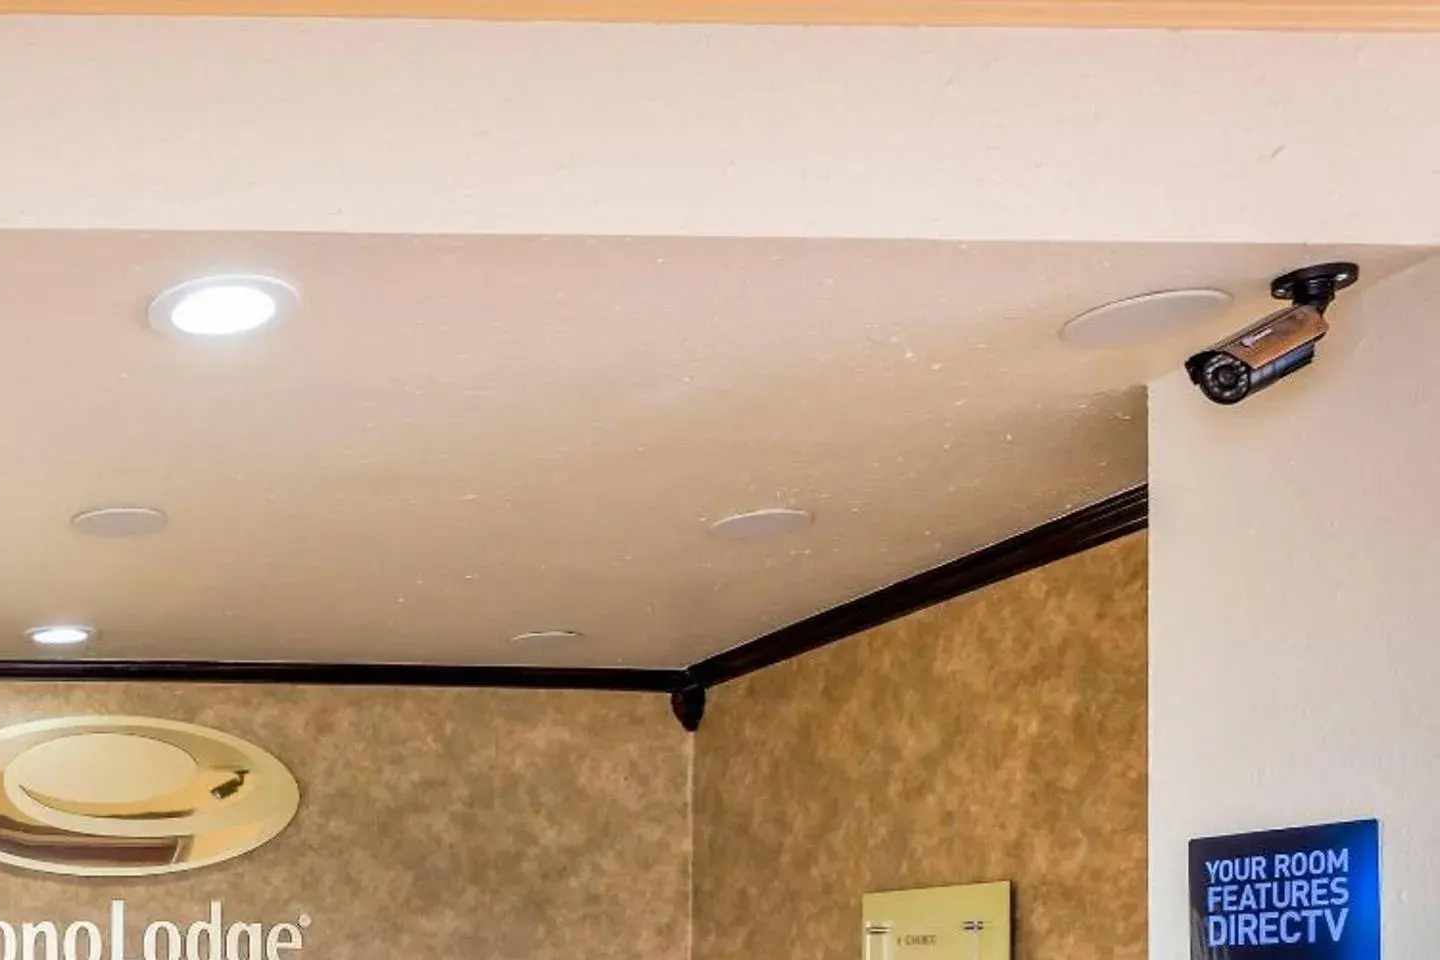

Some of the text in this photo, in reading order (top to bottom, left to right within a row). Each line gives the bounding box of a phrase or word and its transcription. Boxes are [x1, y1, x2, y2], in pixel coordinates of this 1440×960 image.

[1205, 848, 1349, 884] YOUR ROOM
[1207, 877, 1350, 913] FEATURES
[1208, 908, 1350, 947] DIRECTV
